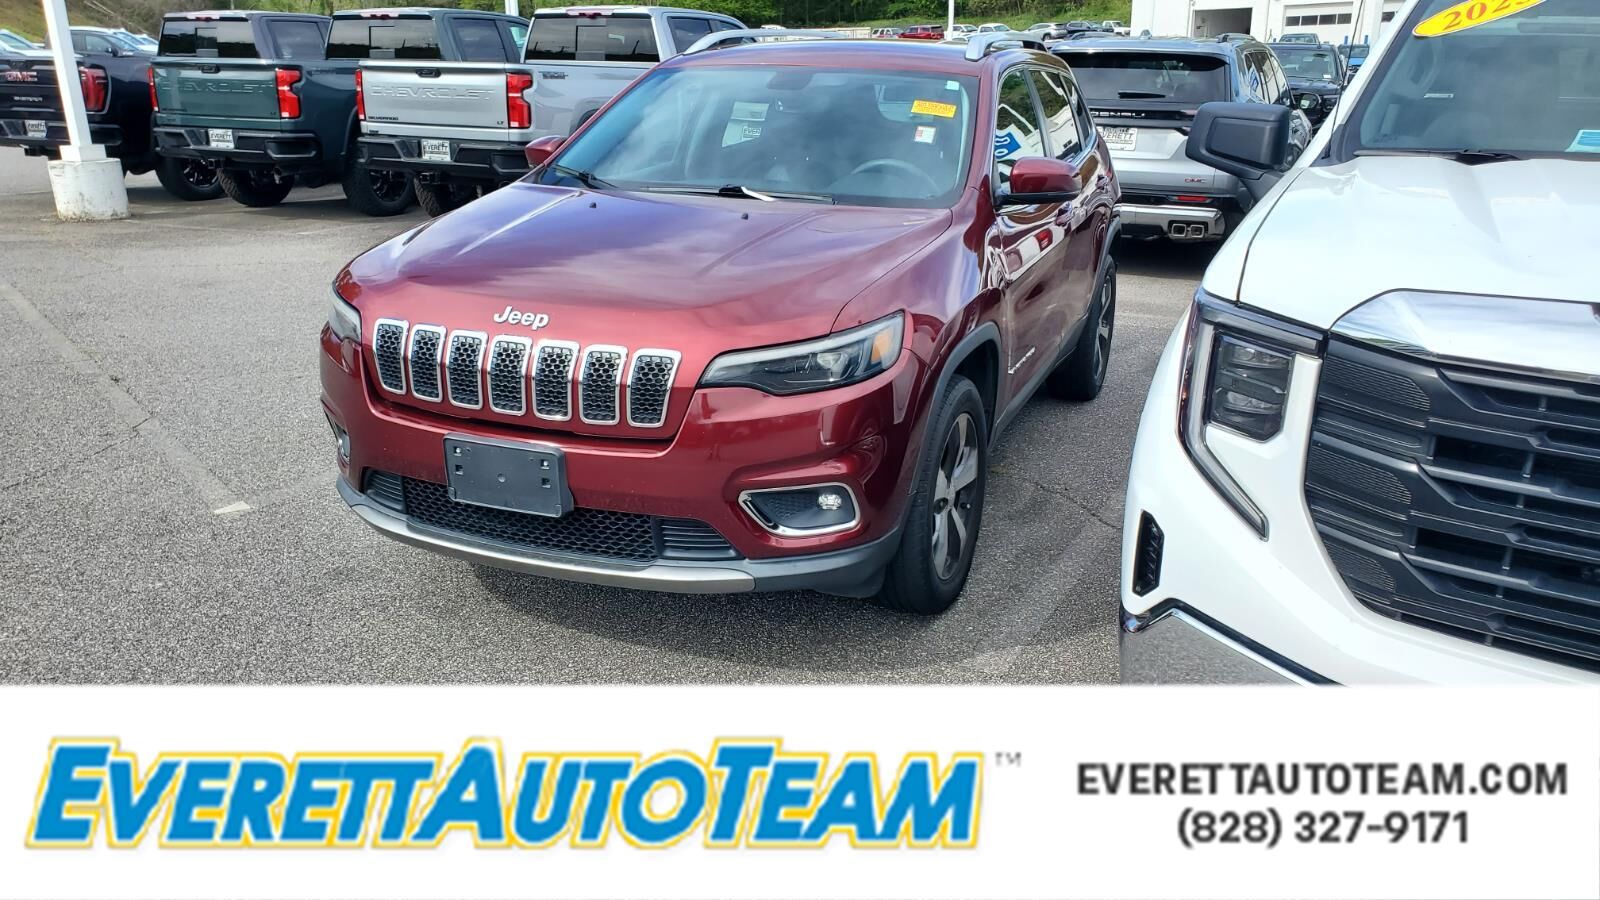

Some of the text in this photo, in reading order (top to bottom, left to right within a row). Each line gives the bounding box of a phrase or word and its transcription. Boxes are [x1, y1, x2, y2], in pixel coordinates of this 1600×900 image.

[370, 85, 495, 100] CHEVROLET
[1100, 130, 1135, 139] VERETT
[493, 305, 549, 331] Jeep
